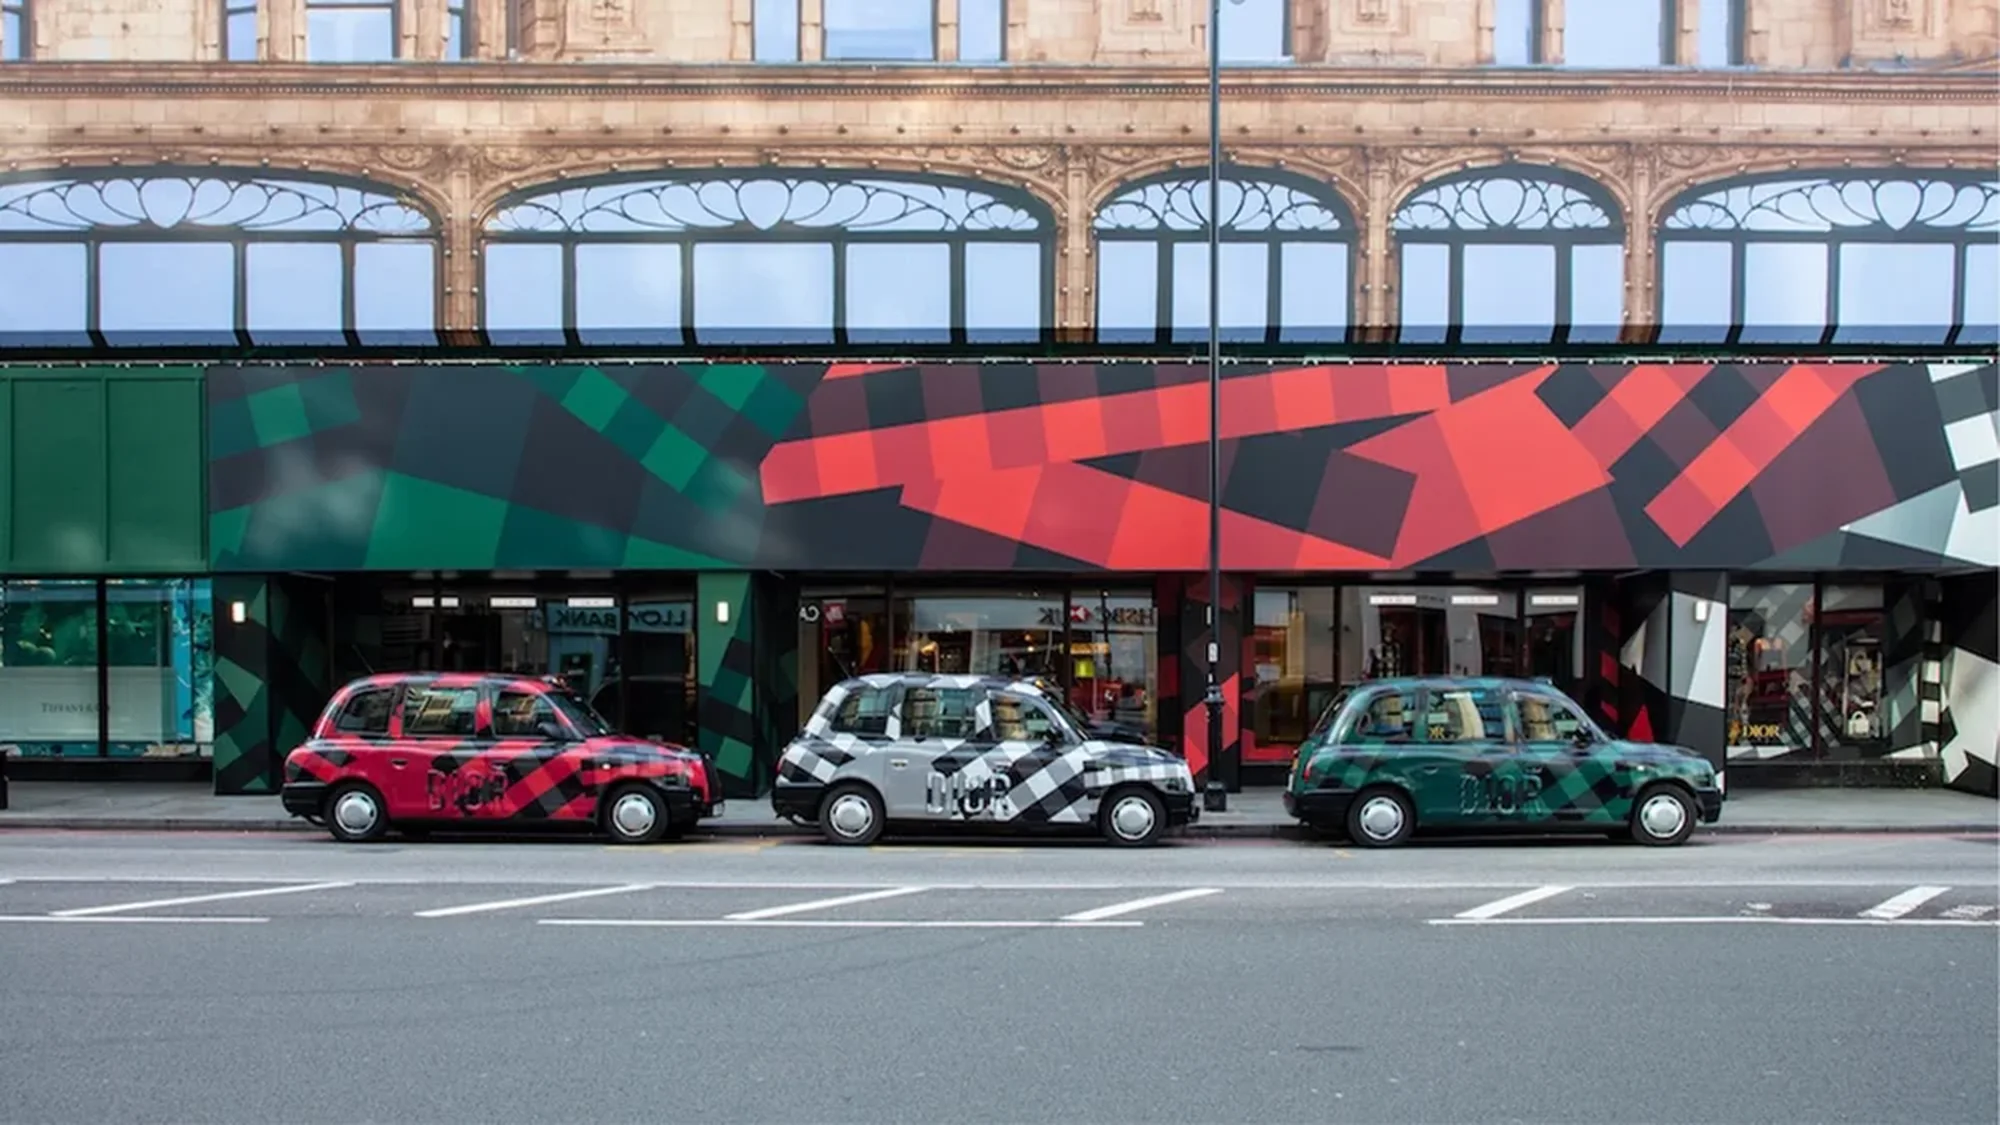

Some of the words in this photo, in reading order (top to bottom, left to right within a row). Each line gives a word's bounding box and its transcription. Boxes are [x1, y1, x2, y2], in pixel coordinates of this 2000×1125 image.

[1743, 723, 1781, 737] DIOR
[427, 768, 510, 812] DIOR
[926, 770, 1012, 815] DIOR
[1459, 773, 1544, 815] DIOR
